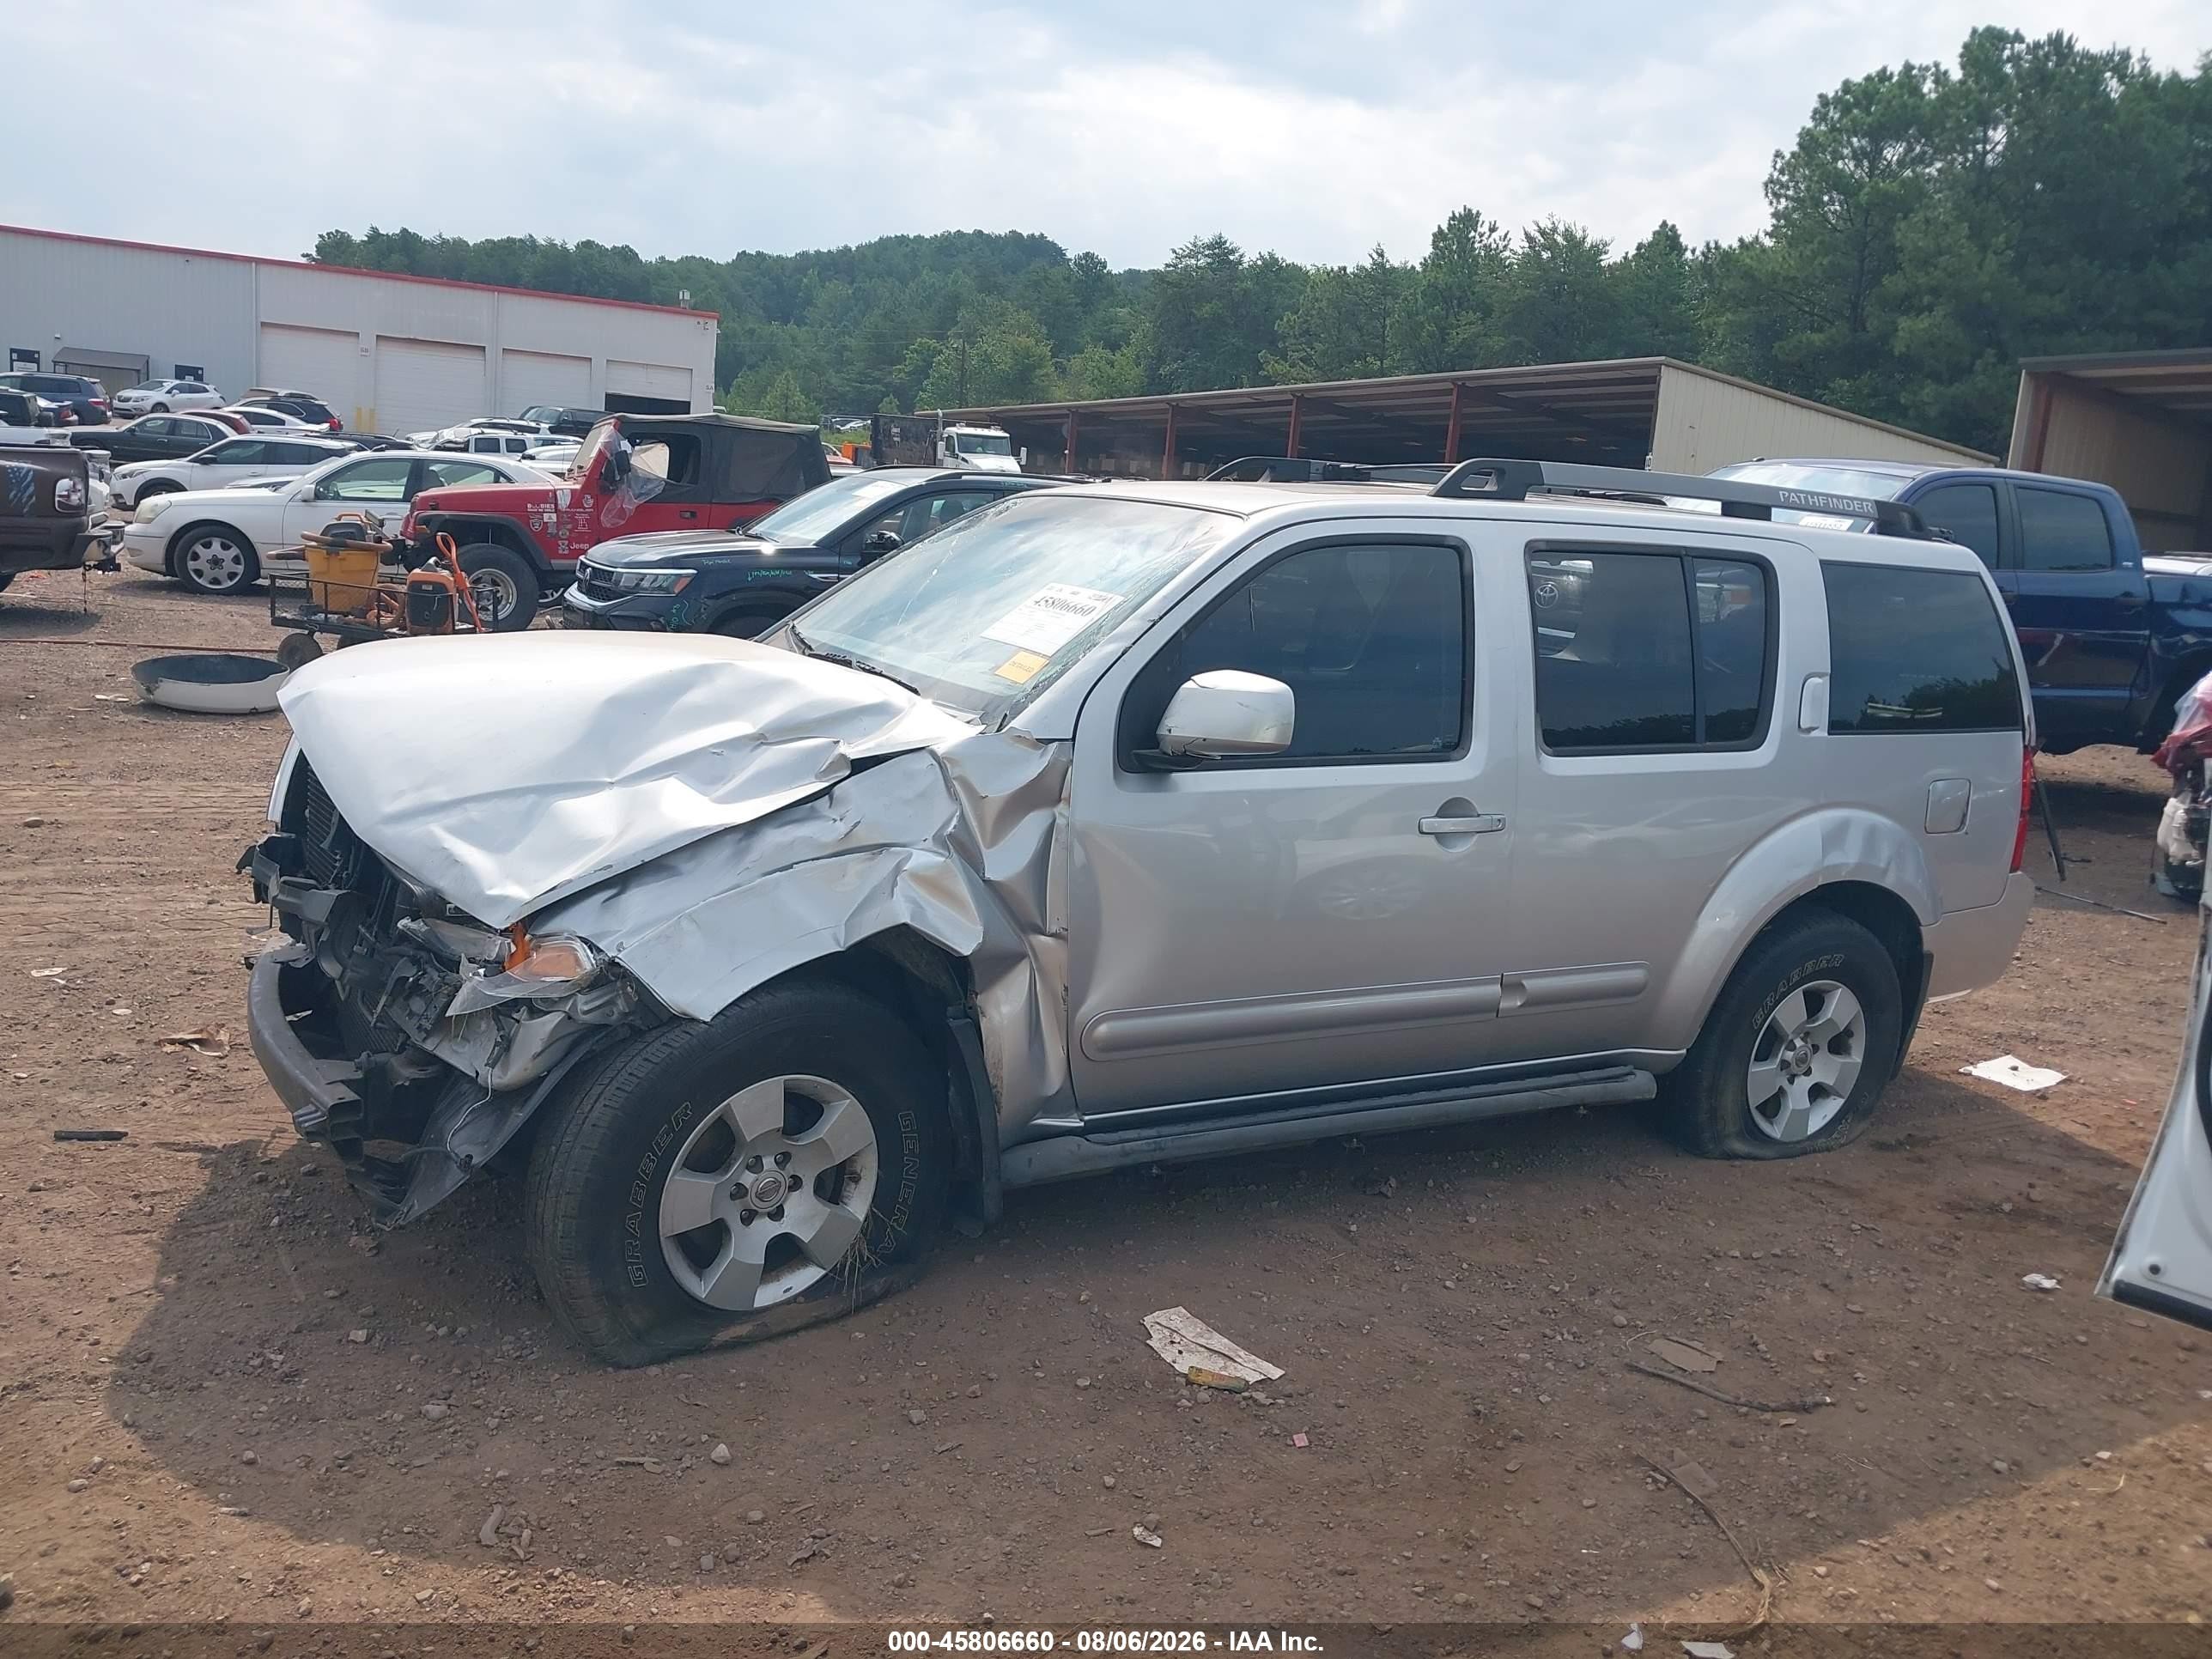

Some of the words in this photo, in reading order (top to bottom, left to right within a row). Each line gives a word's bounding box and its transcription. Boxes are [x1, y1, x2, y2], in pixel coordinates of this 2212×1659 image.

[1778, 490, 1875, 514] PATHFINDER
[1034, 596, 1097, 617] 45806660
[1751, 953, 1844, 1030] GRABBER
[625, 1102, 693, 1288] GRABBER
[873, 1110, 920, 1257] GENERA
